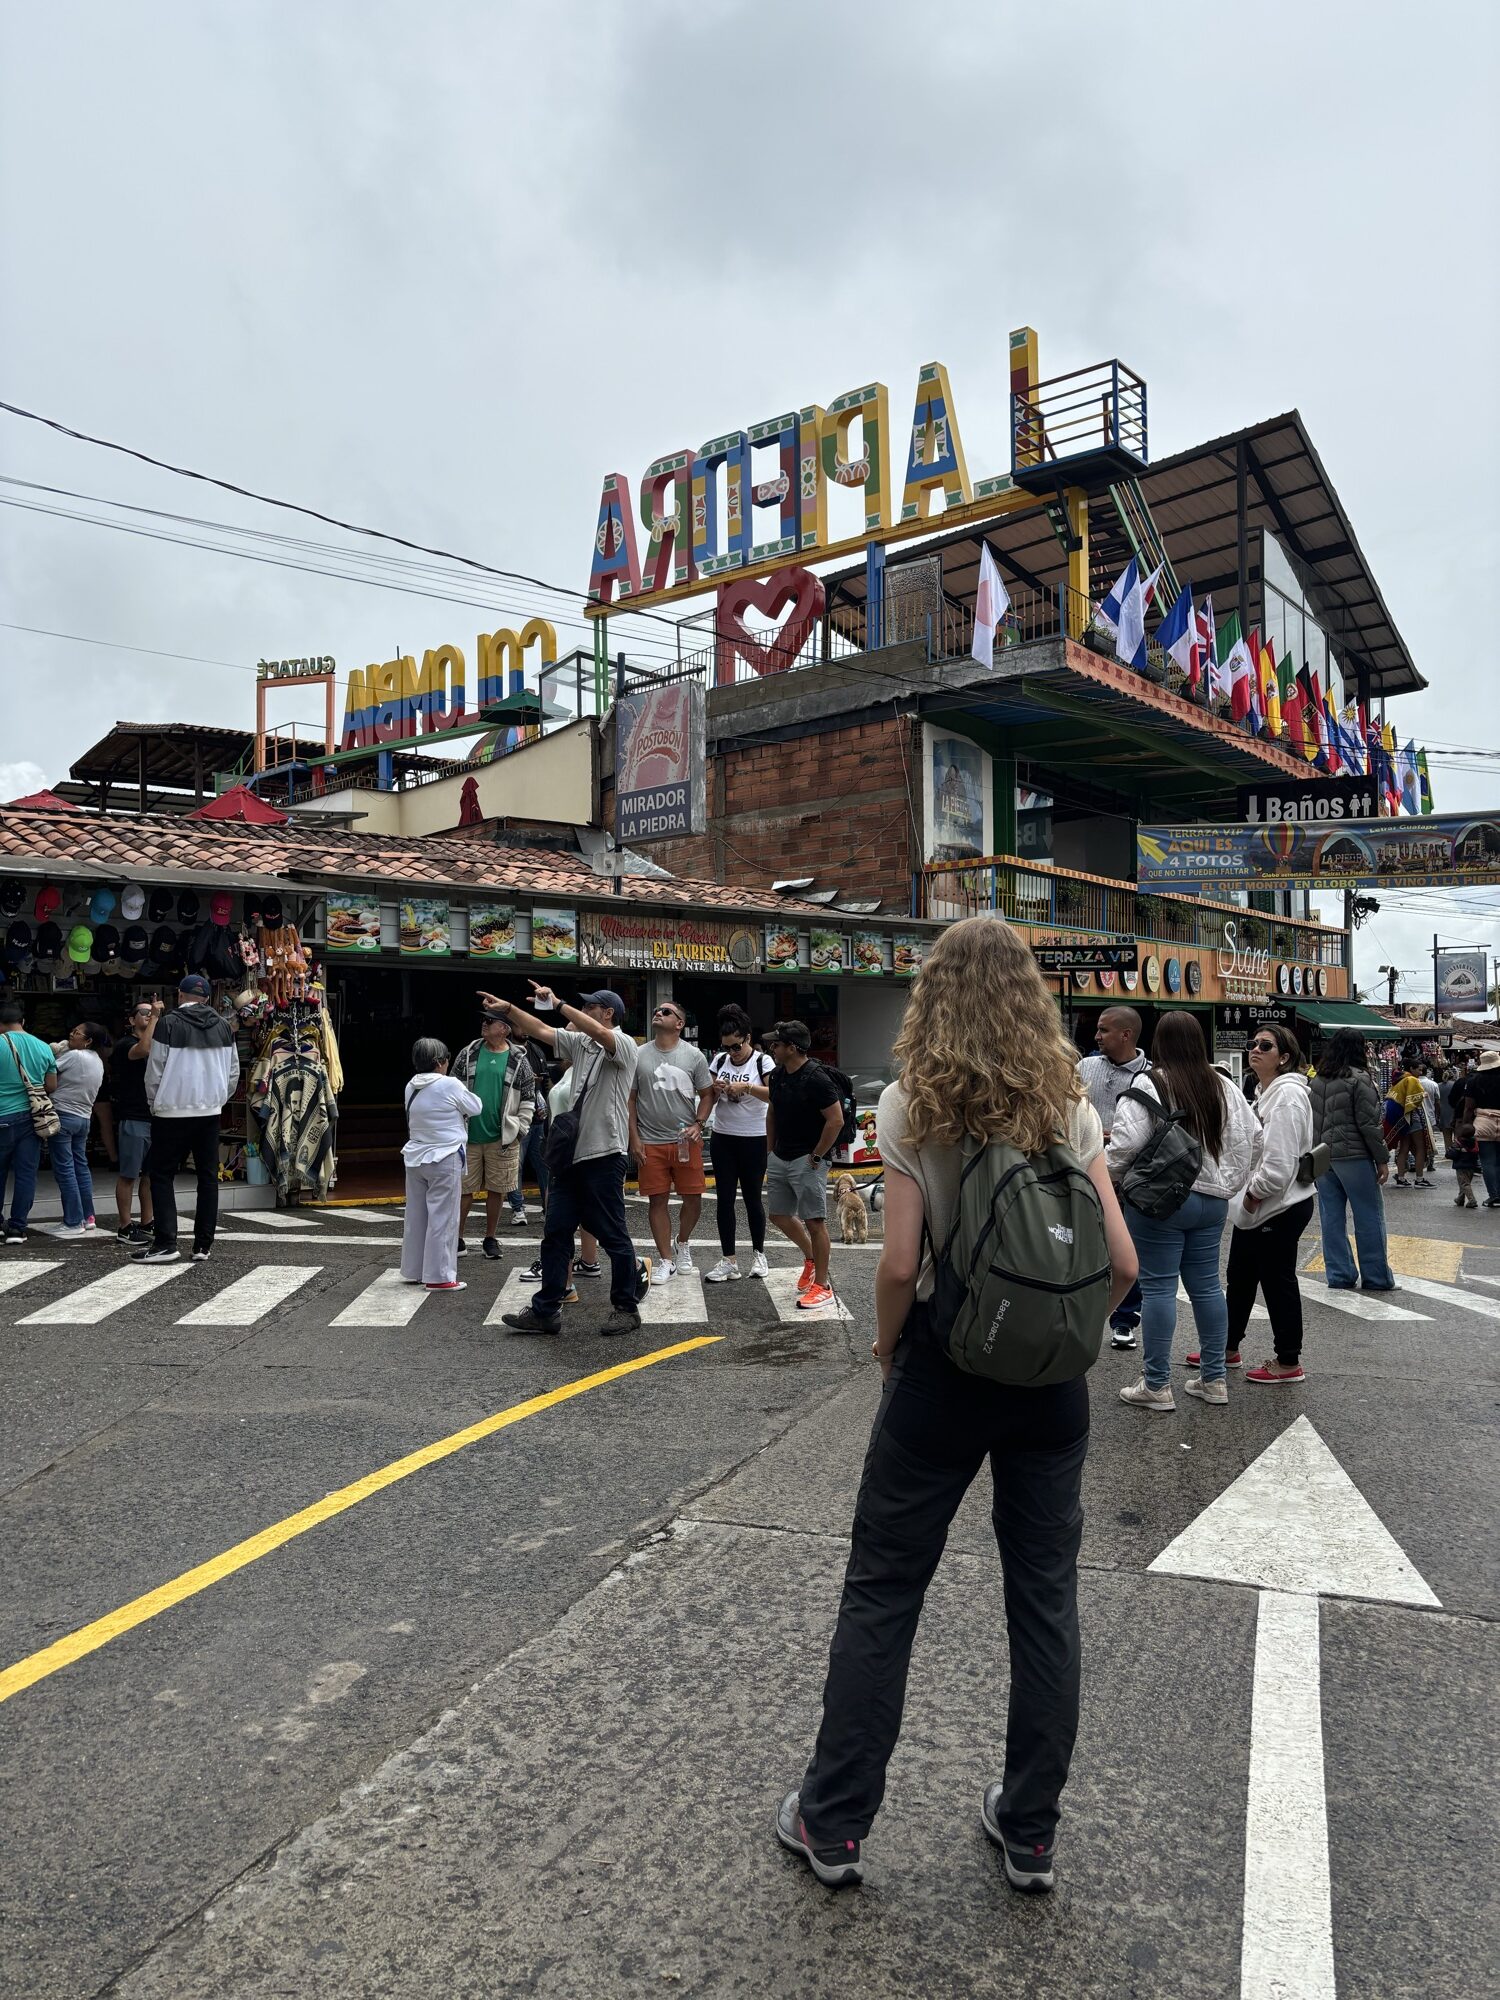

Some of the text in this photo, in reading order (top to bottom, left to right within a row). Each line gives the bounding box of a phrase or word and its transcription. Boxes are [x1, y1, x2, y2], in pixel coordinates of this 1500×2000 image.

[621, 788, 686, 816] MIRADOR
[1265, 794, 1345, 821] Baños
[621, 812, 686, 837] LA PIEDRA
[1168, 828, 1244, 838] TERRAZA VIP
[1167, 840, 1211, 853] AQUI
[1169, 854, 1244, 867] 4 FOTOS
[1148, 870, 1163, 878] QUE
[1188, 868, 1219, 876] PUEDEN
[1220, 867, 1249, 875] FALTAR
[1201, 883, 1215, 891] EL
[1218, 881, 1243, 891] QUE
[1294, 880, 1310, 889] EN
[1313, 878, 1368, 889] GLOBO...
[1377, 878, 1391, 887] SI
[1394, 876, 1427, 888] VINO
[1430, 876, 1439, 886] A
[1443, 875, 1459, 885] LA
[600, 915, 648, 941] Mirador
[652, 940, 672, 959] EL
[674, 942, 728, 963] TURISTA
[1034, 950, 1135, 964] TERRAZA VIP
[713, 961, 735, 973] BAR
[1248, 1006, 1287, 1019] Baños
[719, 1071, 750, 1082] PARIS
[995, 1298, 1011, 1321] Back
[986, 1320, 1000, 1342] pack
